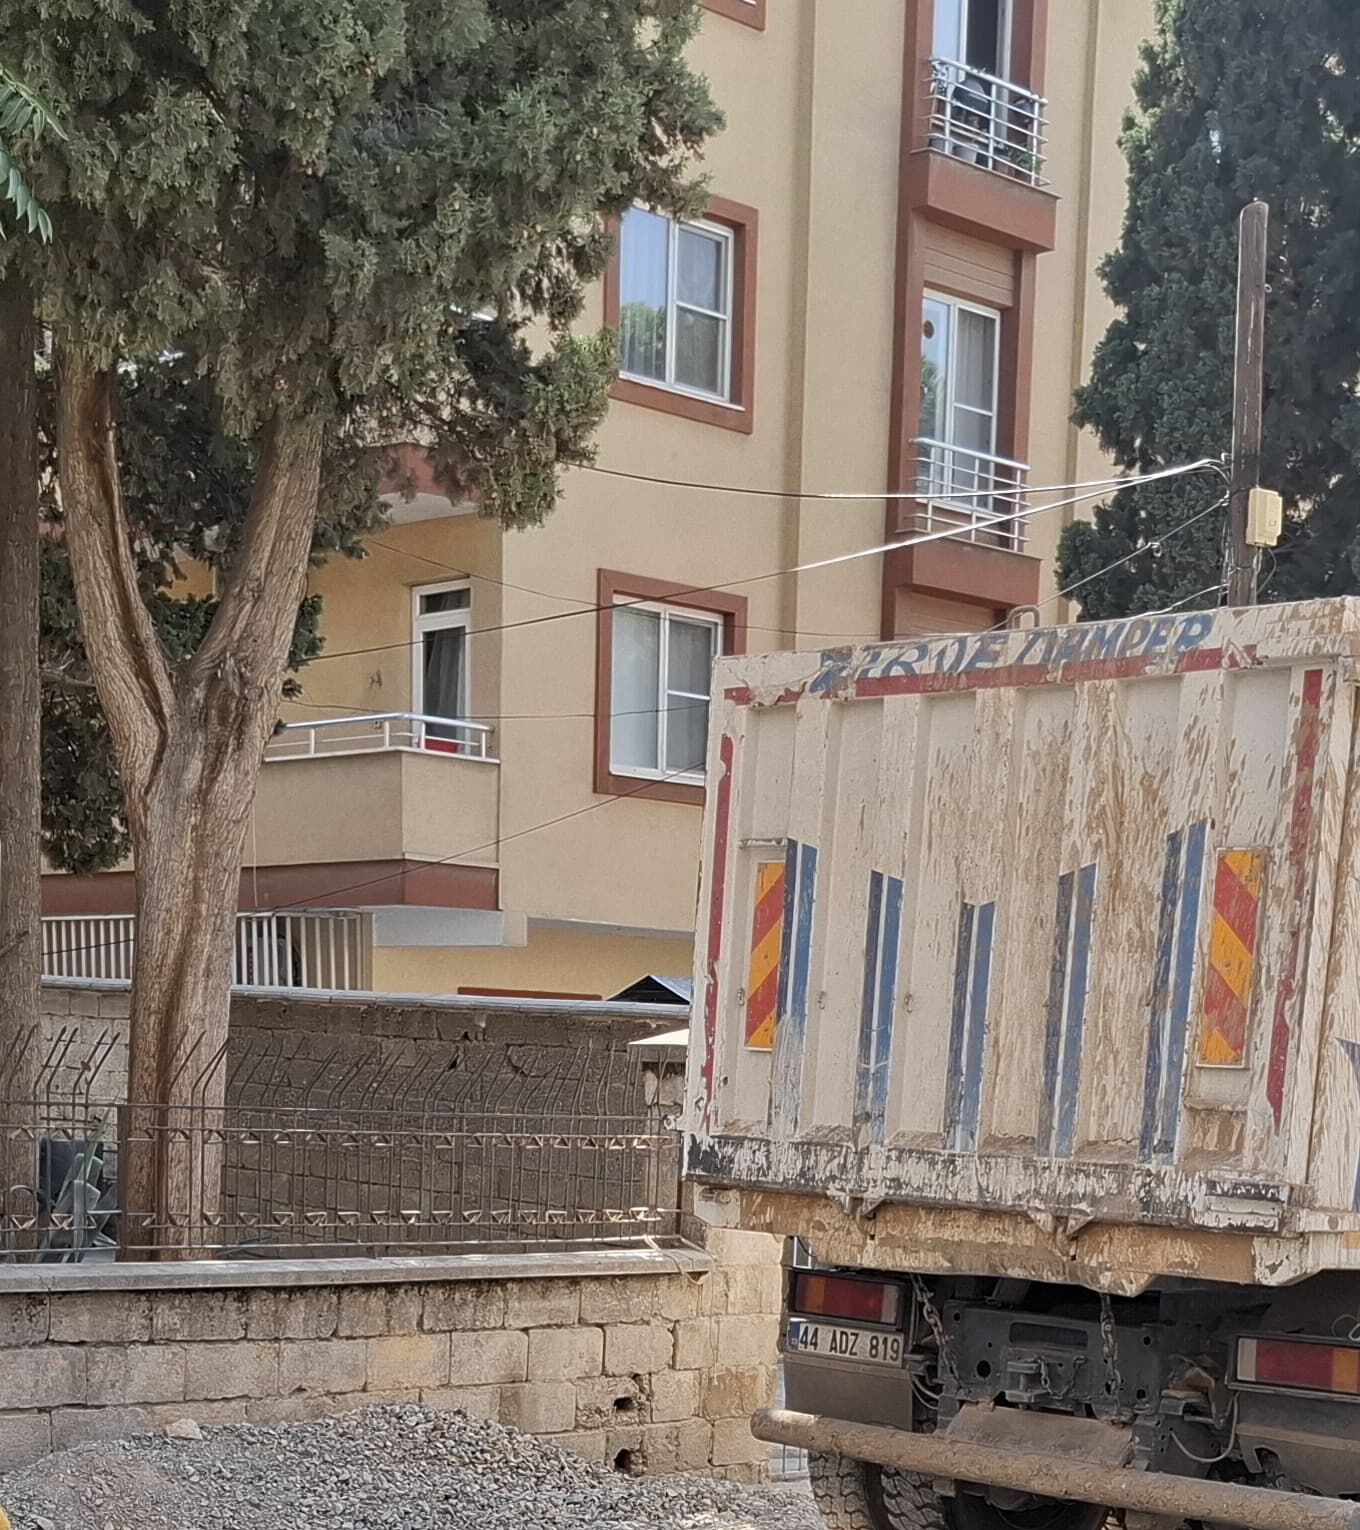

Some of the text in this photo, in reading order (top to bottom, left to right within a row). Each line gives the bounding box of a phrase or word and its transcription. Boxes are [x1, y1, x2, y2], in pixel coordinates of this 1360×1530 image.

[800, 1325, 900, 1362] 44 ADZ 819
